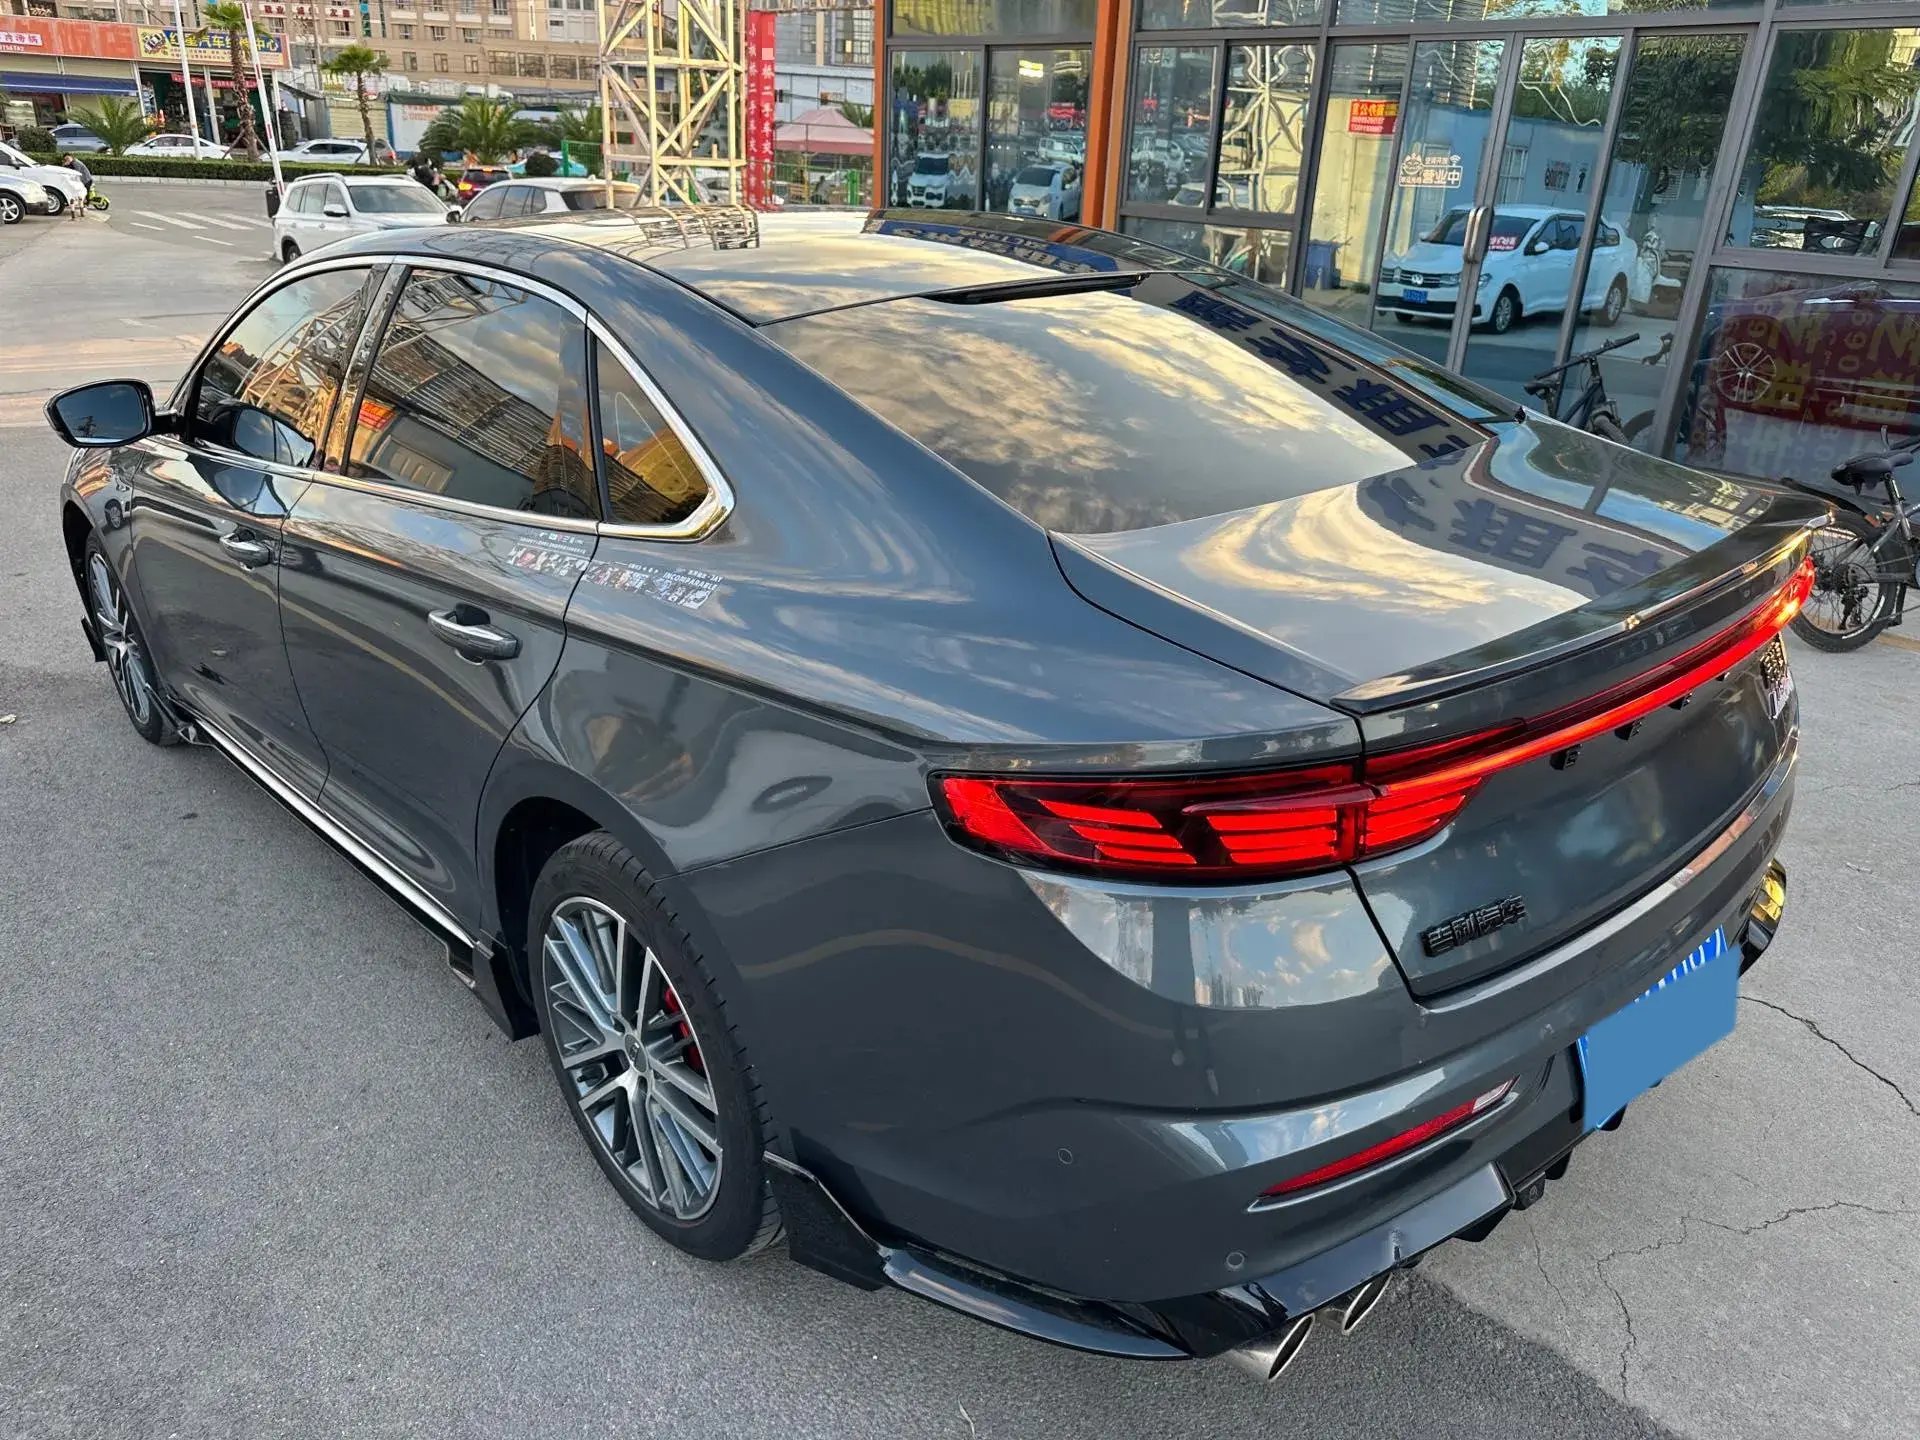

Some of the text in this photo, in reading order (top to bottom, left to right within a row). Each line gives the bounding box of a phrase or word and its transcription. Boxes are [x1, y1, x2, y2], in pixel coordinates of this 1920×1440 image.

[1423, 169, 1460, 184] 营业中
[663, 572, 718, 590] INCOMPARABLE
[1419, 895, 1525, 957] 吉利汽车
